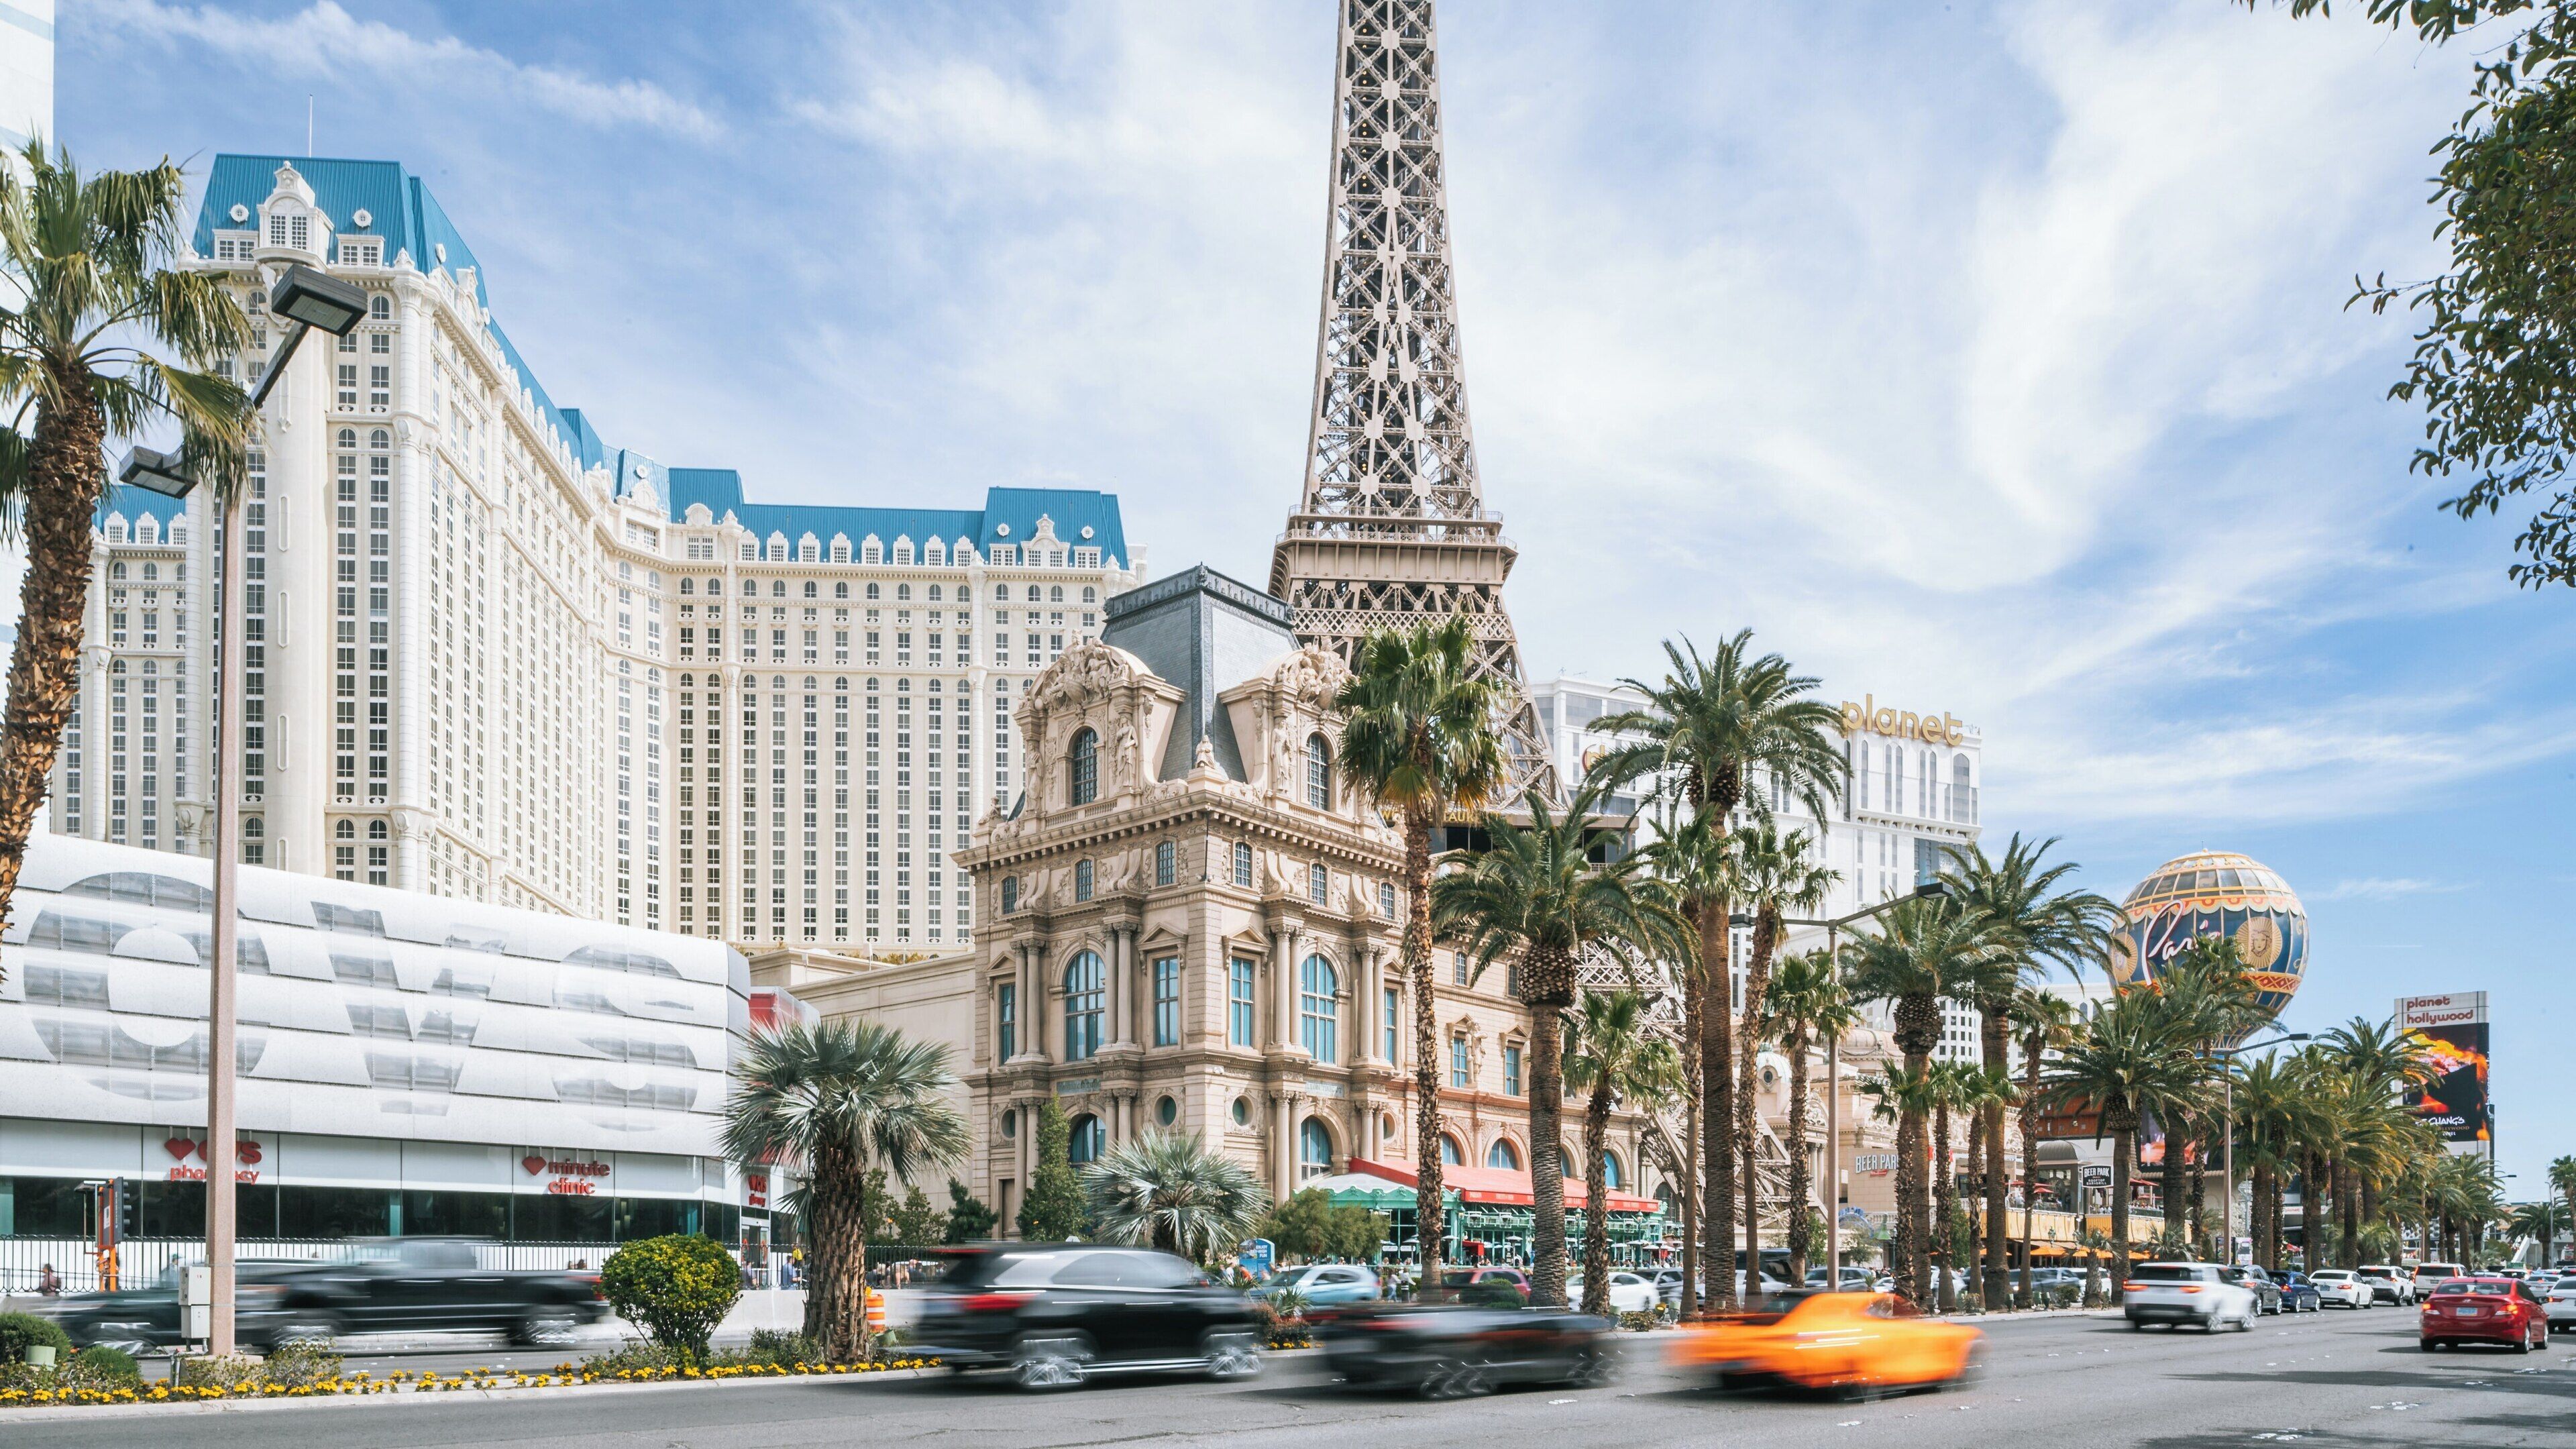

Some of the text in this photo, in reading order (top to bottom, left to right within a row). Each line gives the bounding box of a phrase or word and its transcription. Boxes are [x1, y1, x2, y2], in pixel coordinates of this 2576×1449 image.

[1842, 693, 1963, 746] planet
[23, 871, 699, 1132] CVS
[2407, 996, 2451, 1012] planet
[2407, 1009, 2473, 1024] hollywood
[548, 1159, 610, 1177] minute
[1856, 1155, 1878, 1174] BEER
[2084, 1167, 2110, 1177] BEER PARK
[548, 1177, 596, 1195] clinic
